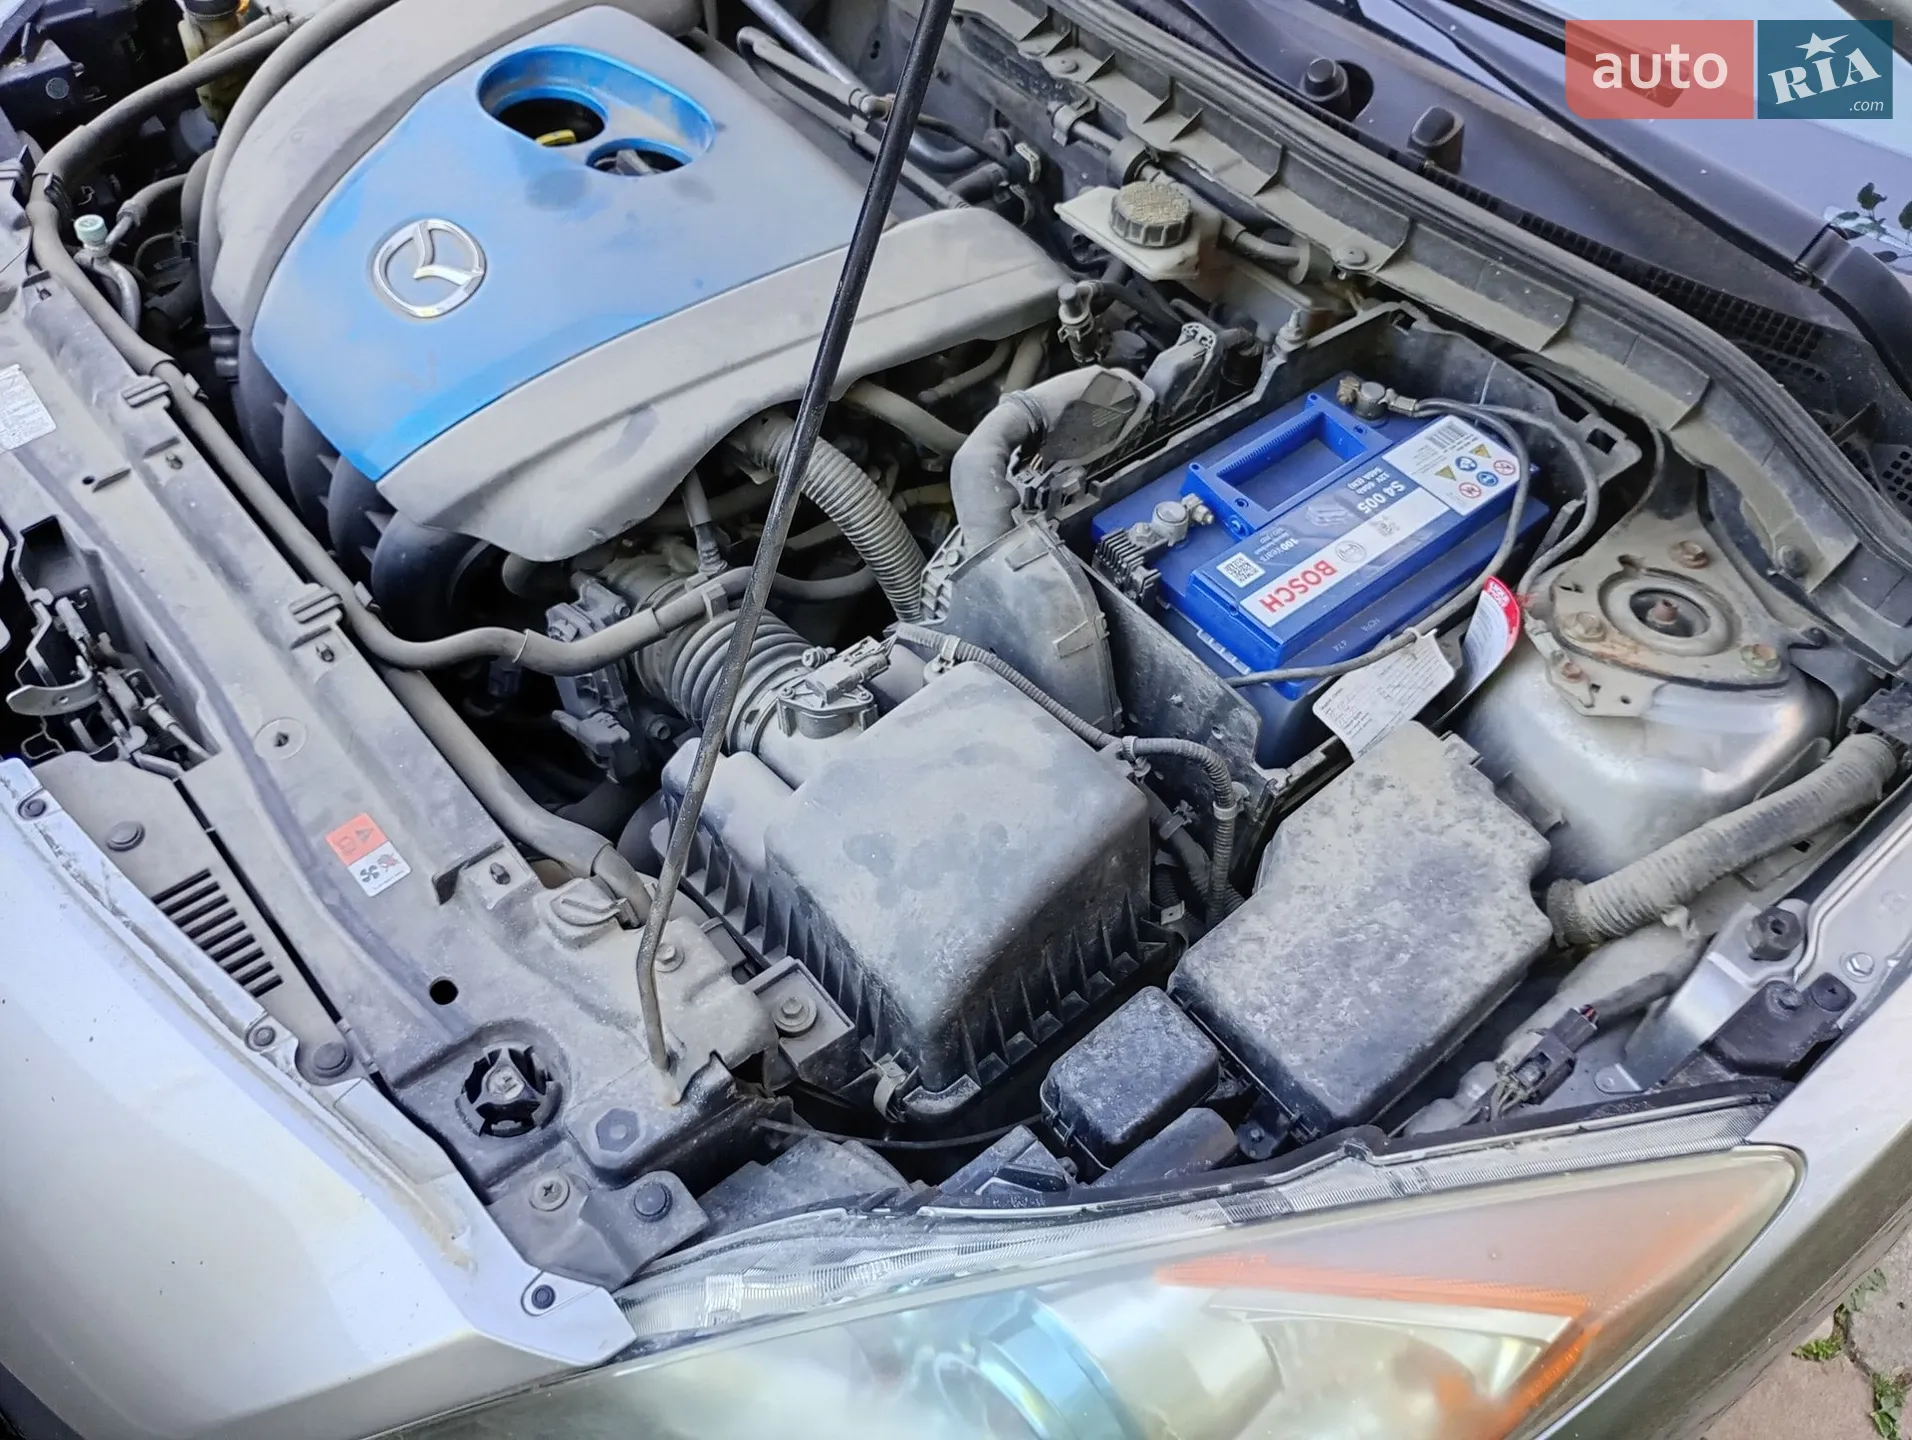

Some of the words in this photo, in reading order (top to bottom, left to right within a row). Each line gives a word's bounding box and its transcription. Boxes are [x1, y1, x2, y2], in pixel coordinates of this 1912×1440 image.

[1382, 481, 1406, 497] S4
[1357, 493, 1386, 513] 005
[1259, 560, 1337, 613] BOSCH
